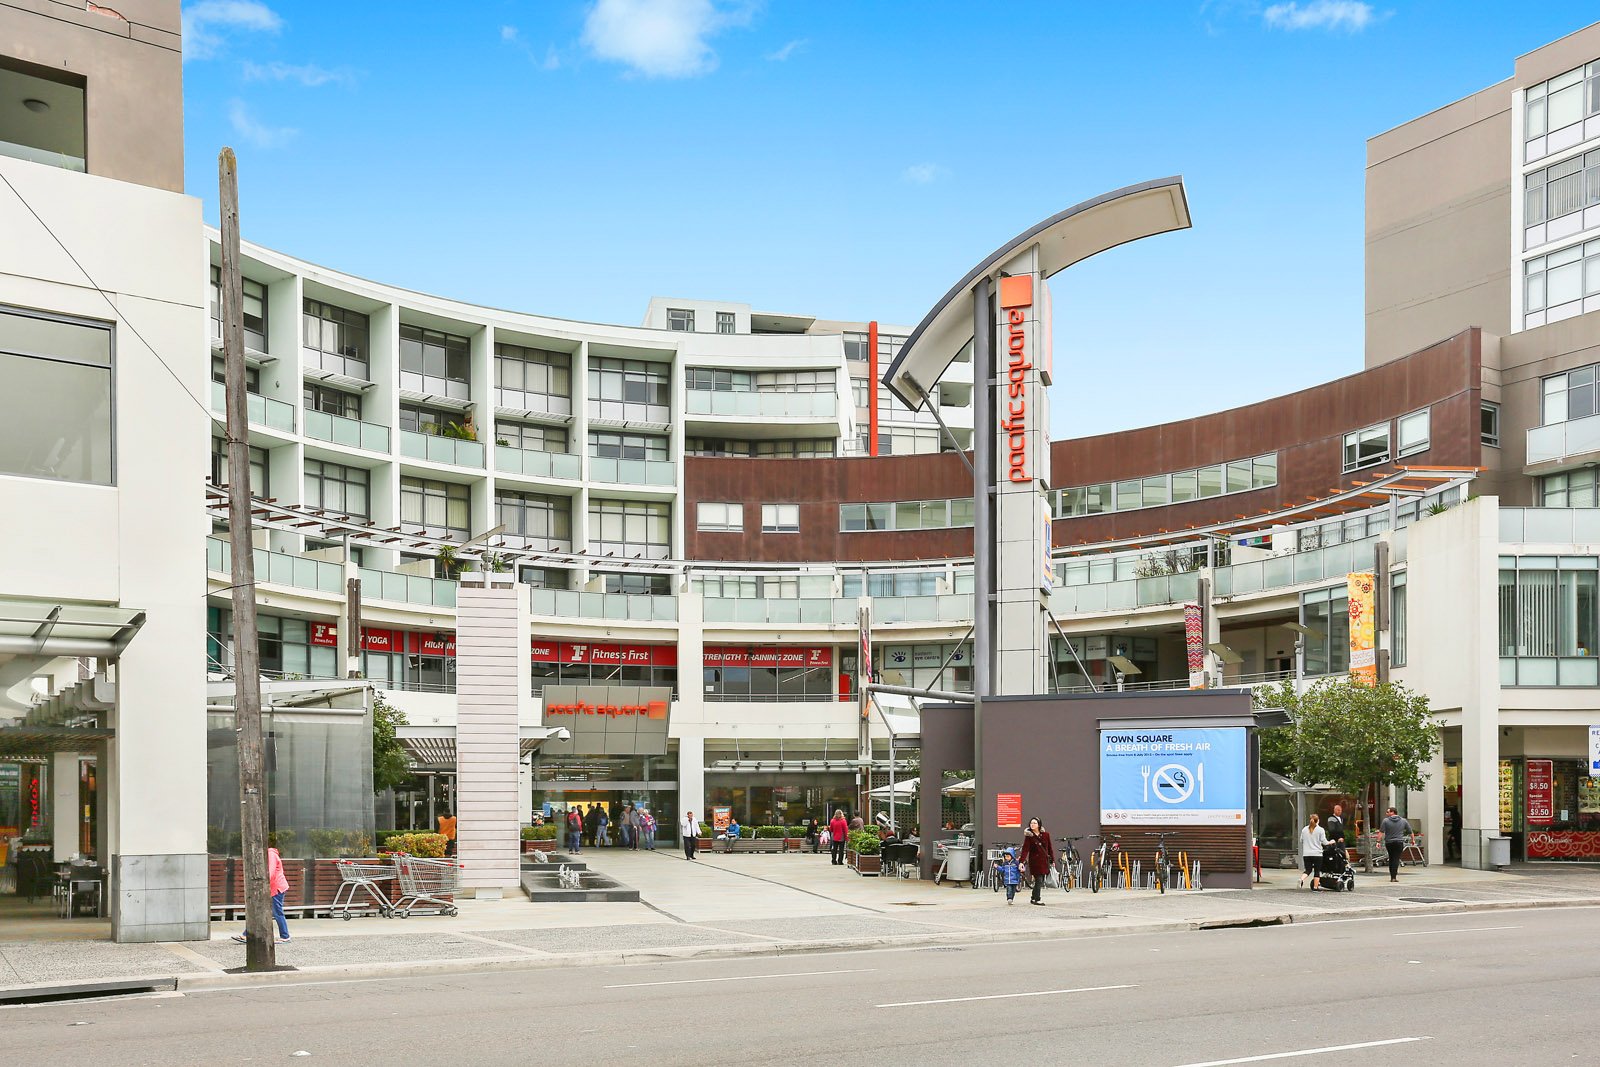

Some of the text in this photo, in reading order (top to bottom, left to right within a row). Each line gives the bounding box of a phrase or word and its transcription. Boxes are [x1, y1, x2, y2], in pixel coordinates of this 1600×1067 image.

[1001, 308, 1032, 483] pacific square
[367, 635, 388, 645] YOGA
[424, 640, 444, 649] HIGH
[531, 648, 550, 656] ZONE
[703, 653, 741, 661] TRENGTH
[546, 700, 648, 719] pacific square
[1106, 734, 1173, 743] TOWN SQUARE
[1105, 742, 1211, 752] A BREATH OF FRESH AIR
[1529, 782, 1549, 790] $8.50
[1530, 808, 1549, 816] $9.50
